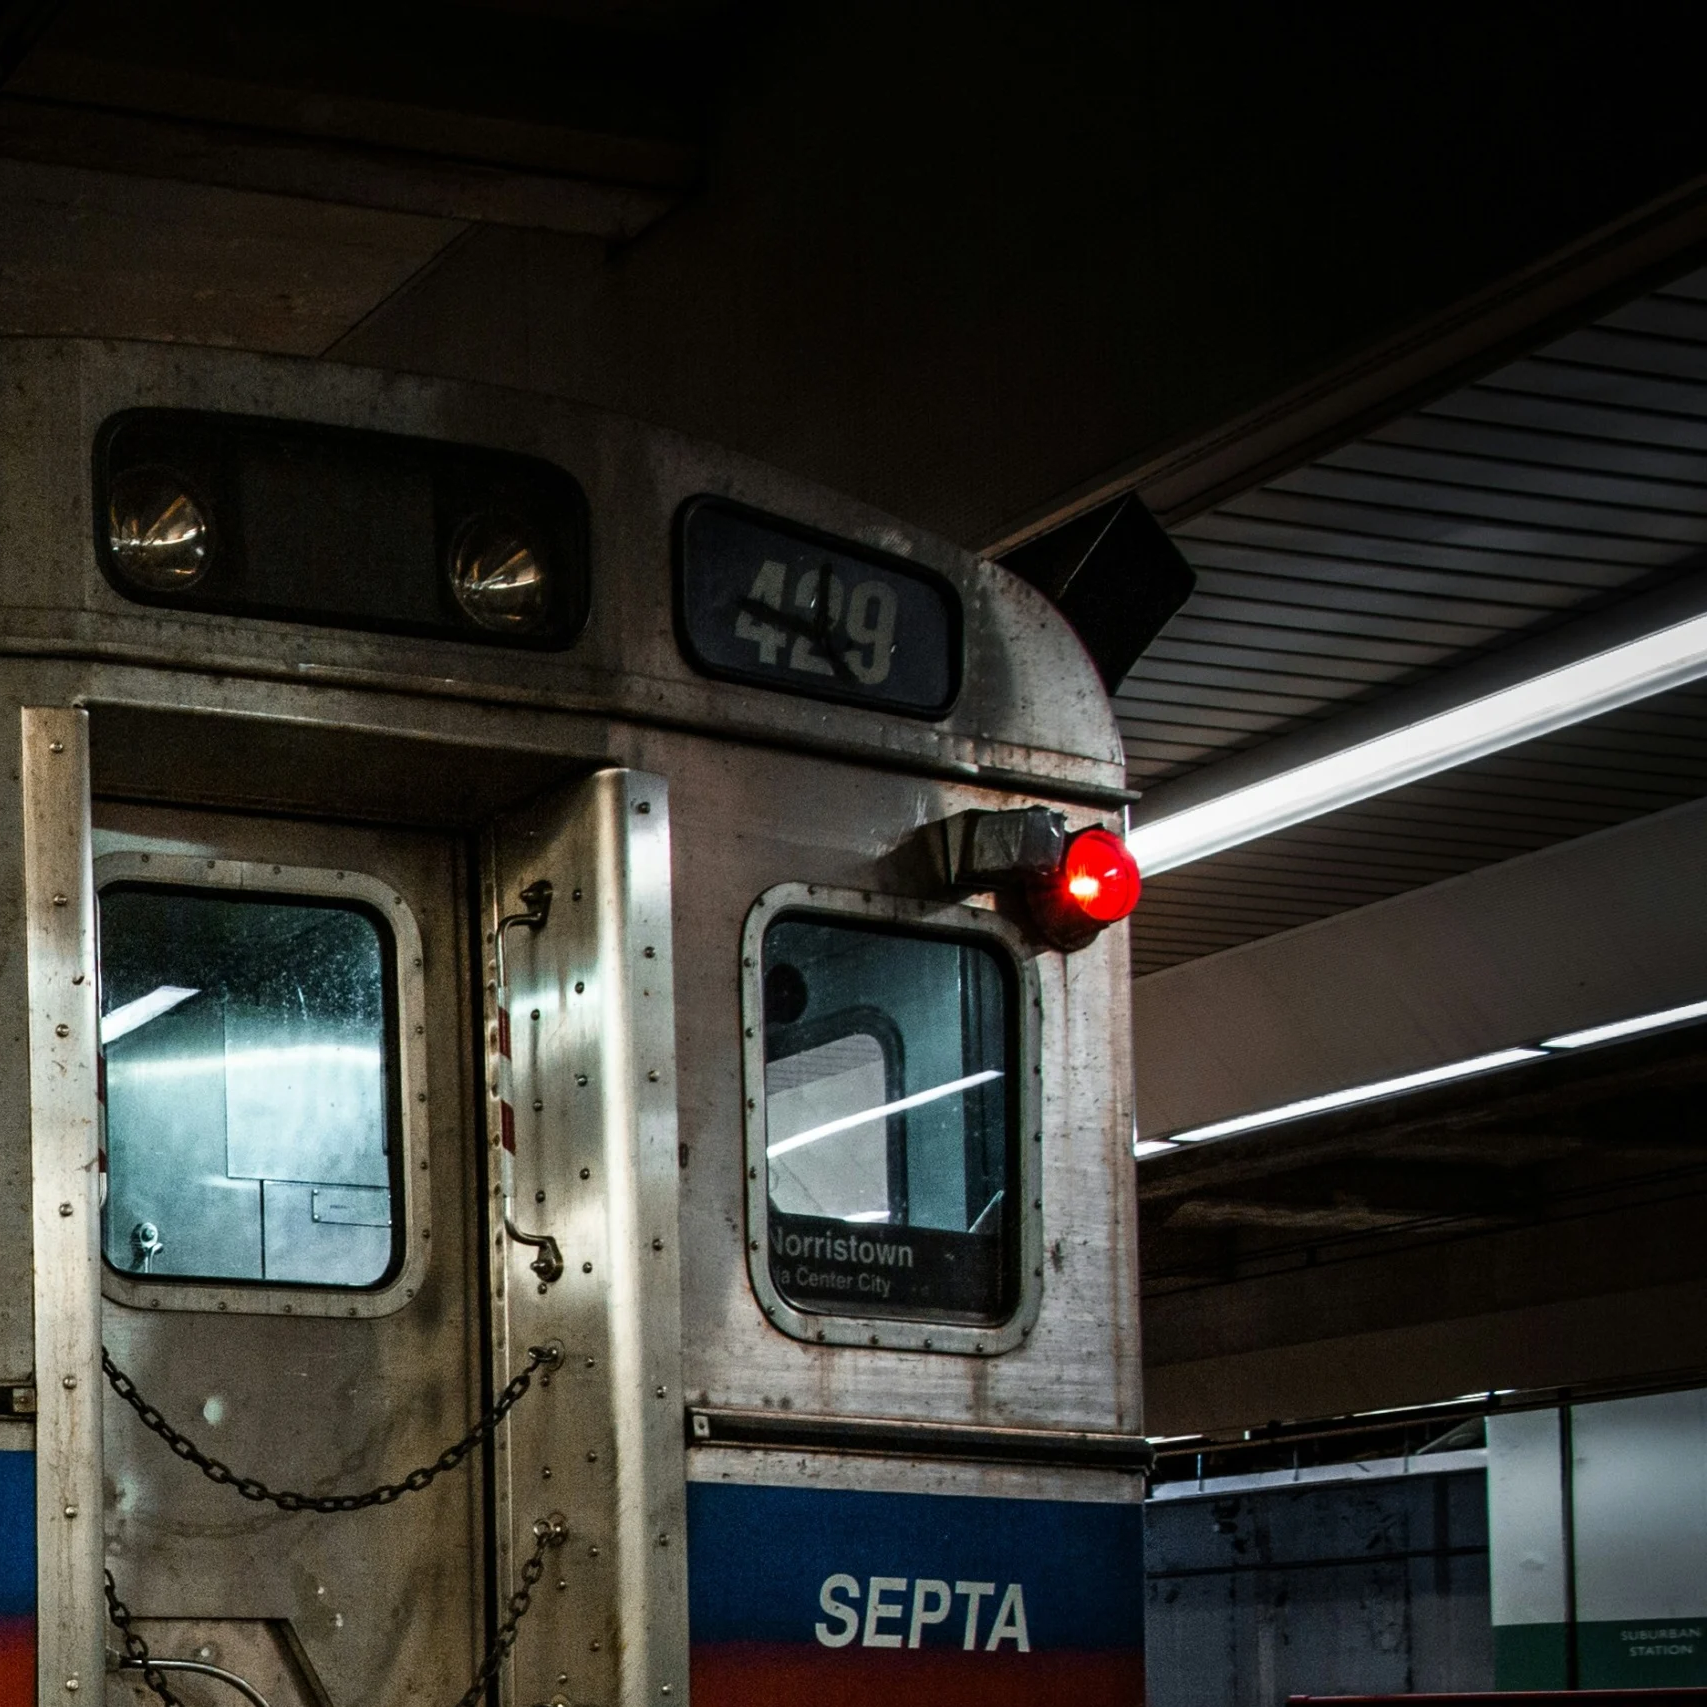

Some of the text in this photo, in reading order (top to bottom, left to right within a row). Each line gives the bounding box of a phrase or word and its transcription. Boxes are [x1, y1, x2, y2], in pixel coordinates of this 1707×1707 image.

[734, 559, 898, 685] 429
[795, 1265, 853, 1290] Center
[858, 1273, 892, 1298] City
[814, 1573, 1031, 1653] SEPTA
[1619, 1627, 1702, 1641] SUBURBAN
[1628, 1644, 1694, 1657] STATION
